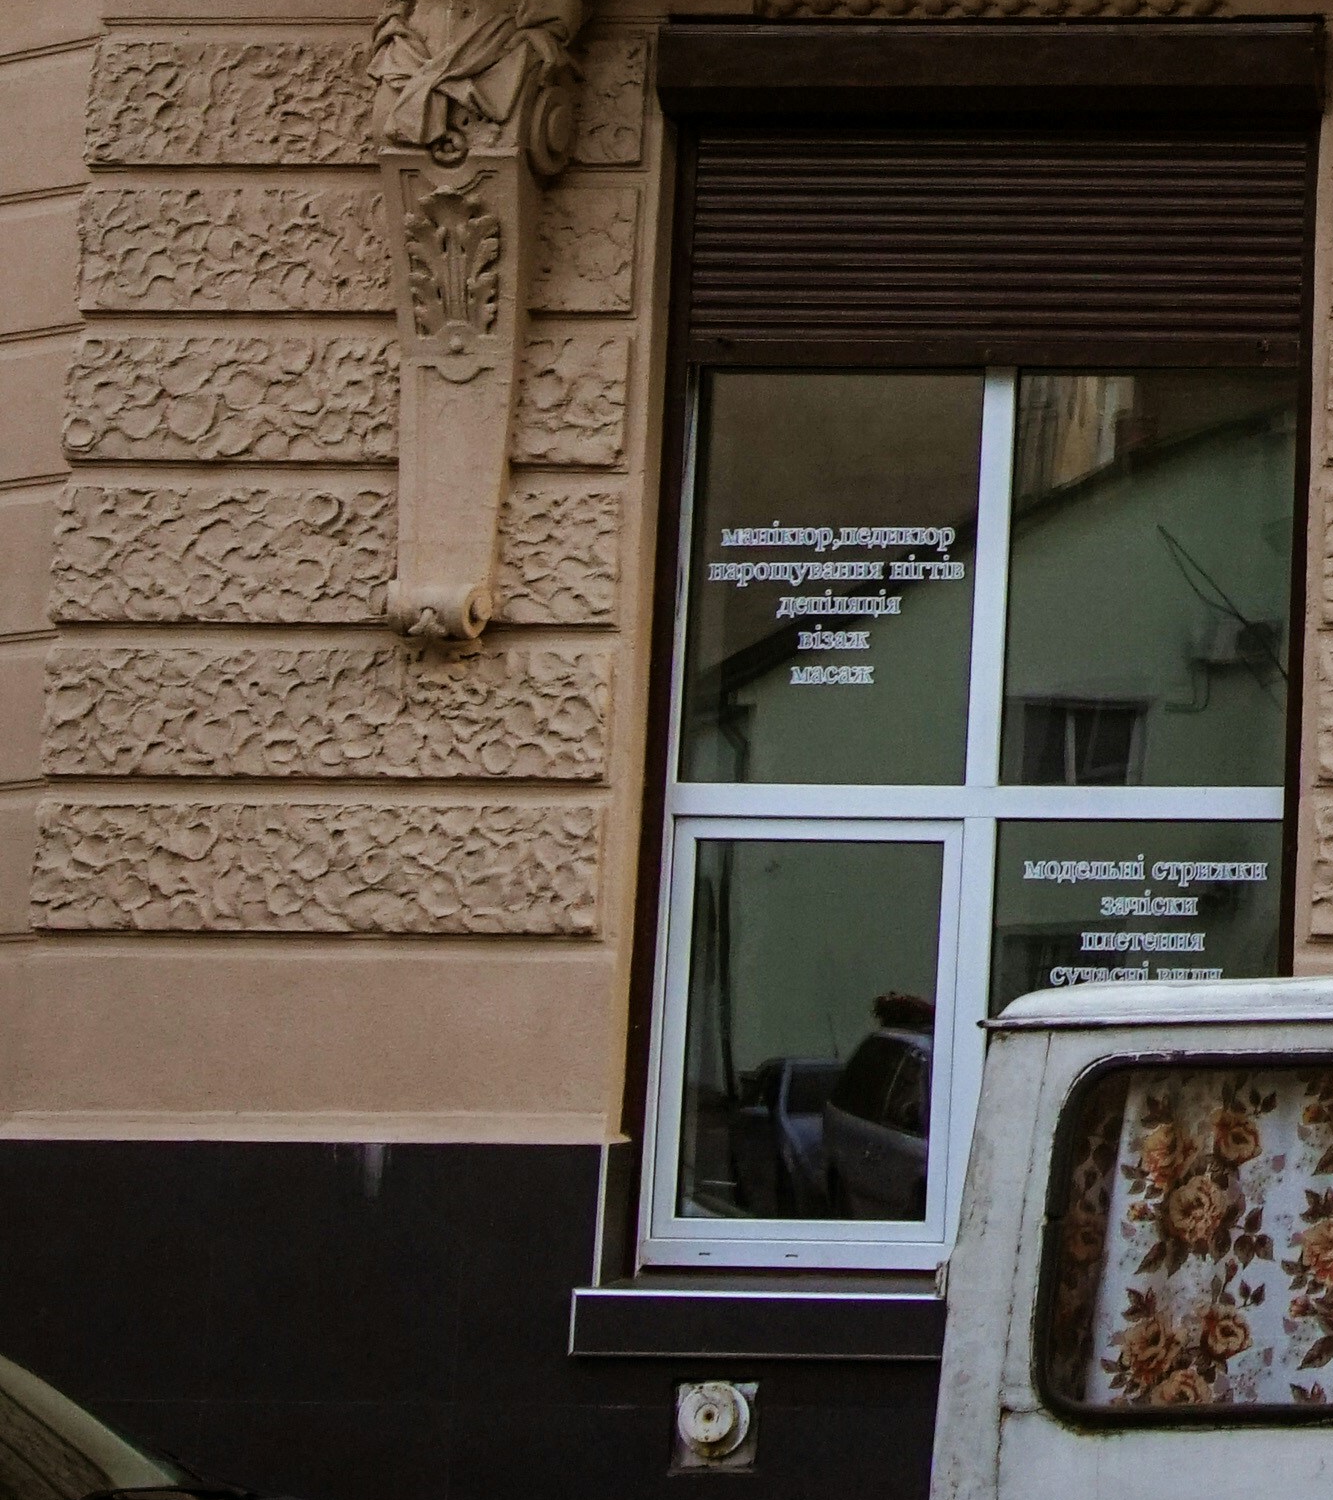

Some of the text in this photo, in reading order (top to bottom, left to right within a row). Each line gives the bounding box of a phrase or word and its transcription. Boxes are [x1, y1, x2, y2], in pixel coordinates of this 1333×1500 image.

[708, 553, 965, 587] нарощування нігтів
[776, 588, 902, 618] депіляція
[797, 623, 870, 650] візаж
[790, 665, 874, 685] масаж
[1023, 854, 1268, 887] модельні стрижки
[1100, 889, 1198, 916] зачіски
[1081, 932, 1206, 951] плетення
